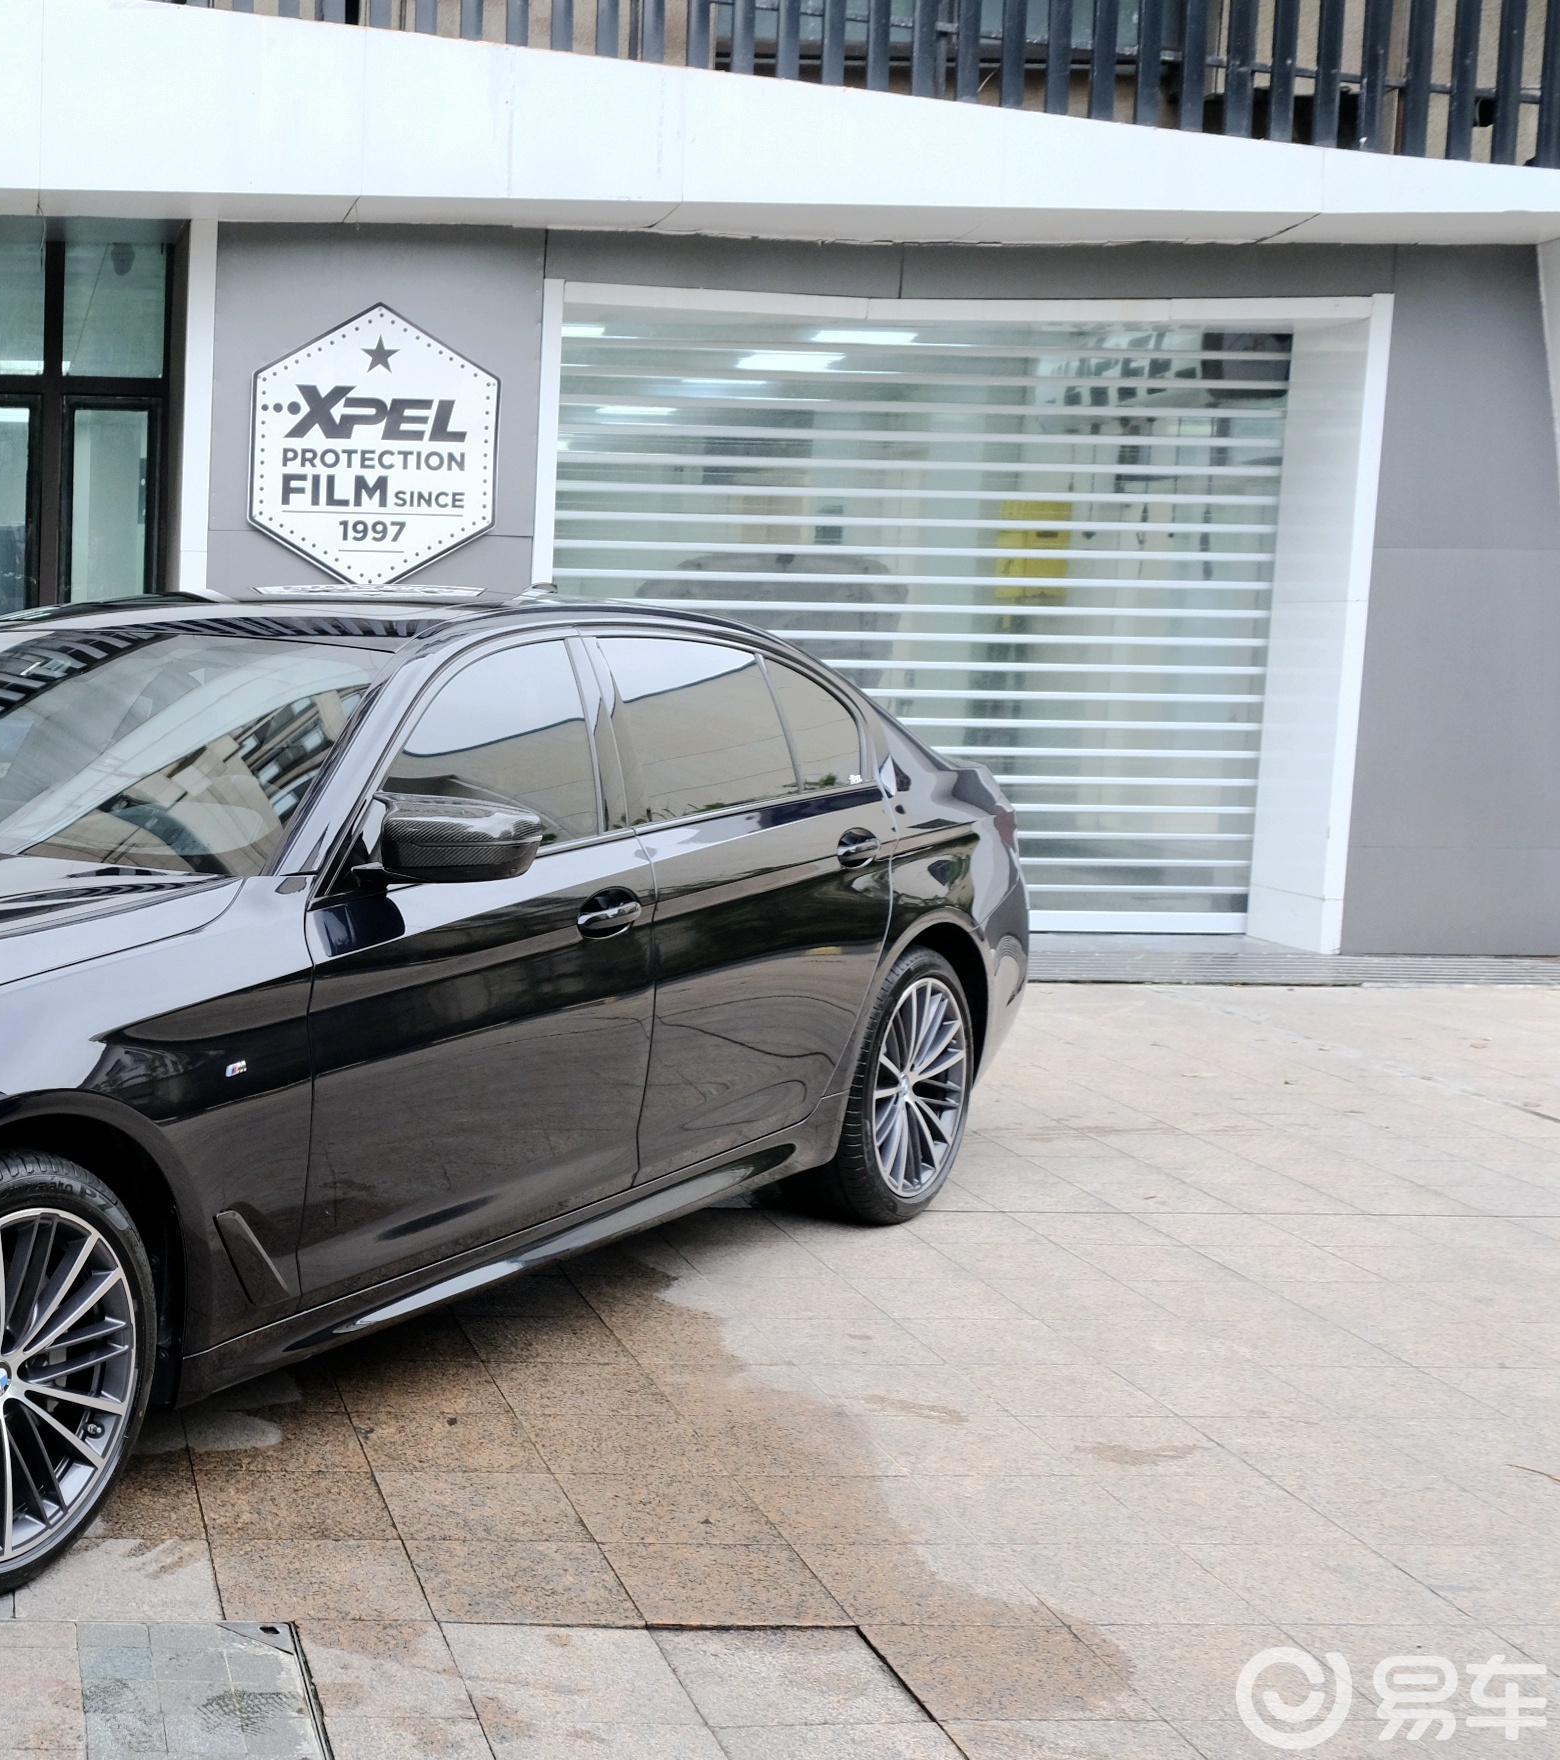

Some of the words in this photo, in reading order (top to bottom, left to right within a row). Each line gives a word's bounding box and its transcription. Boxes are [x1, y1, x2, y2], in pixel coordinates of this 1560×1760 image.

[283, 384, 468, 443] XPEL
[282, 447, 465, 471] PROTECTION
[281, 473, 389, 508] FILM
[394, 490, 465, 508] SINCE
[339, 519, 407, 542] 1997
